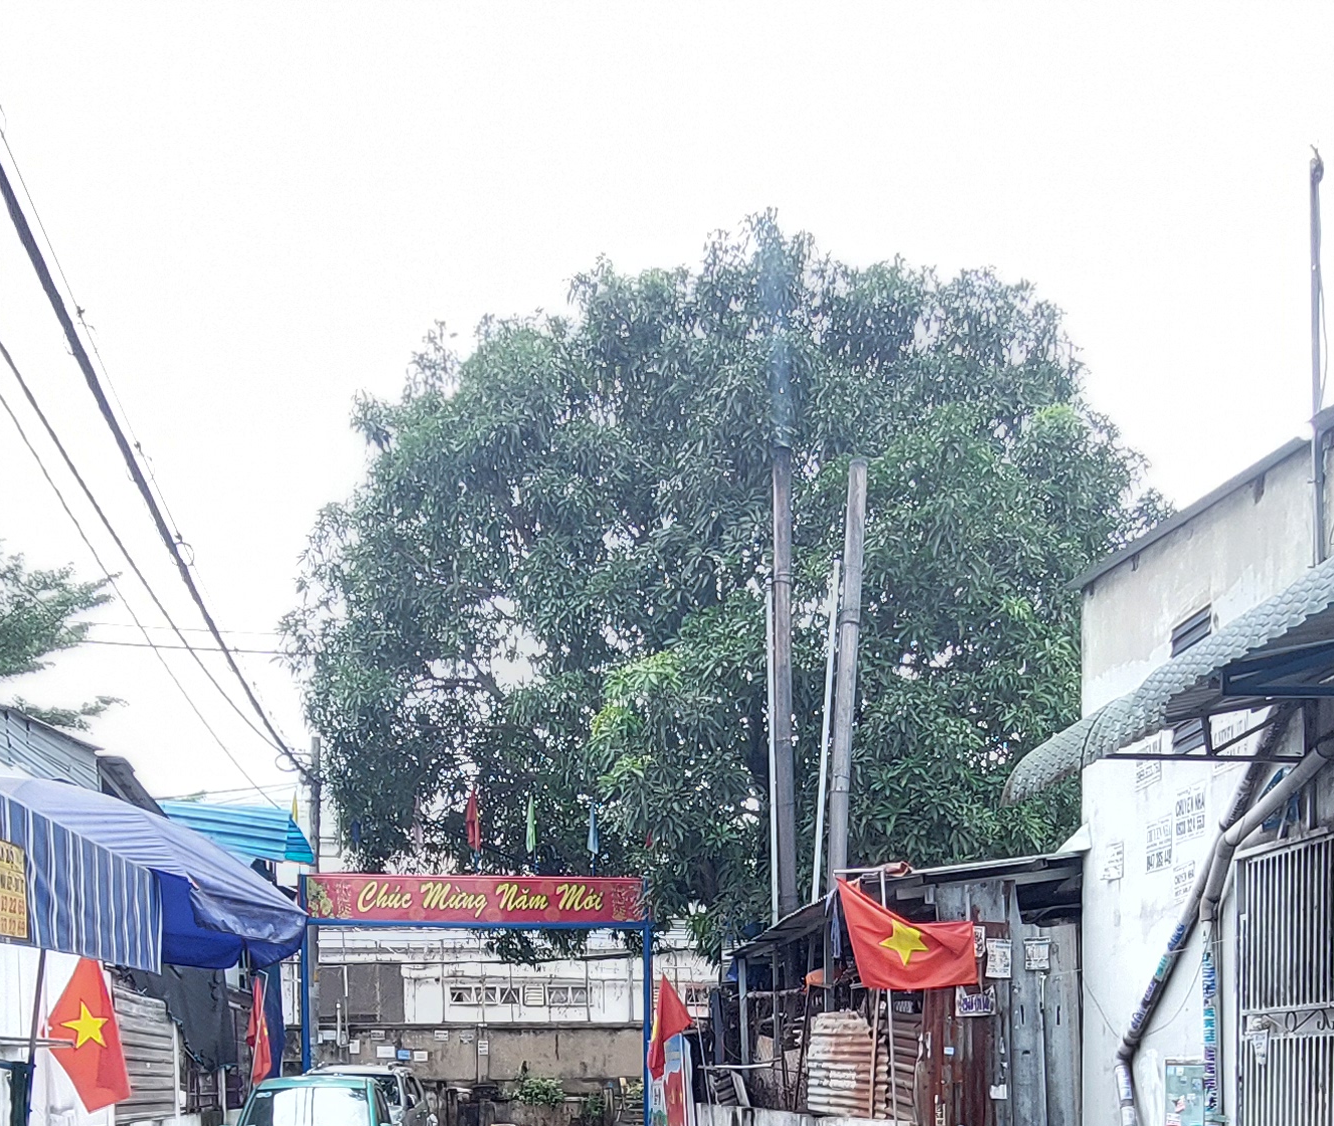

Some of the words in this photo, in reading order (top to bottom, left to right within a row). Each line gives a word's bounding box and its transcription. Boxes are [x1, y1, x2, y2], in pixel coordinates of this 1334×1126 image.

[357, 881, 412, 913] Chúc
[420, 883, 487, 918] Mừng
[496, 883, 549, 912] Năm
[557, 883, 603, 912] Mới
